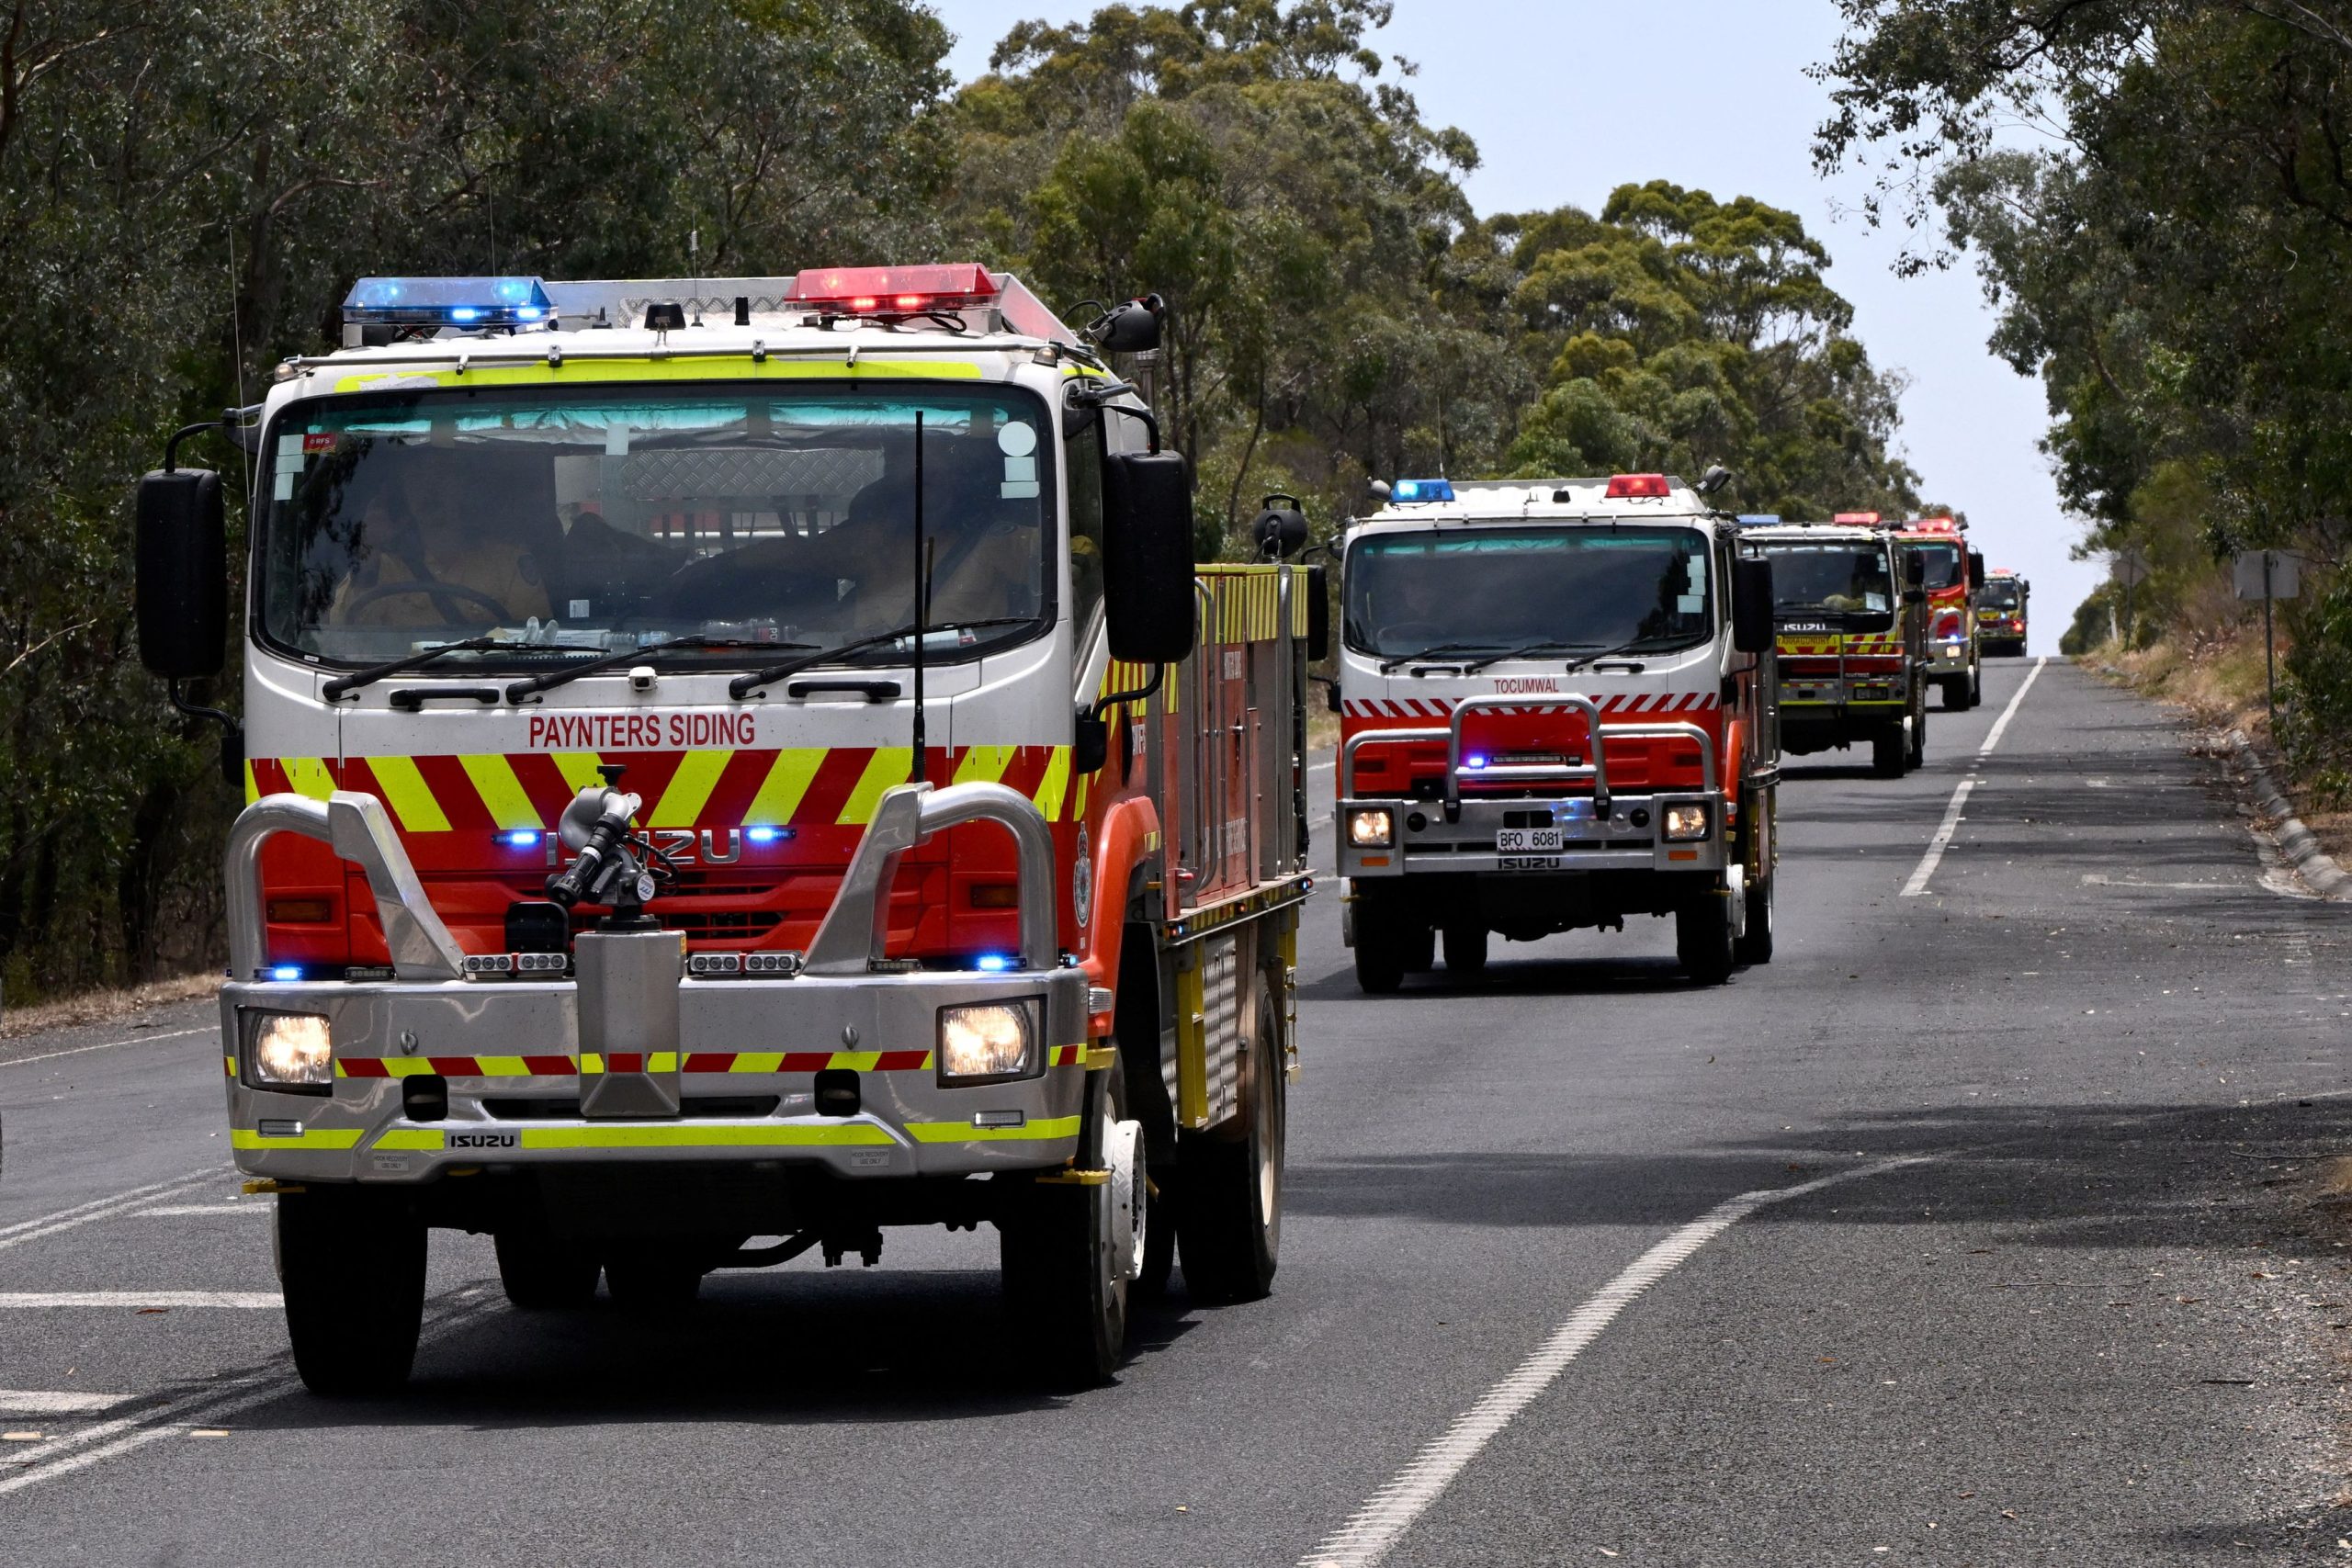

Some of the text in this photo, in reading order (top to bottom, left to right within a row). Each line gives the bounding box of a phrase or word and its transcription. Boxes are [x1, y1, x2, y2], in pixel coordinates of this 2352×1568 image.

[1783, 623, 1826, 631] ISUZU
[1494, 678, 1559, 694] TOCUMWAL
[529, 714, 755, 748] PAYNTERS SIDING
[1500, 832, 1559, 847] BFO 6081
[1498, 857, 1560, 870] ISUZU
[450, 1135, 514, 1148] ISUZU
